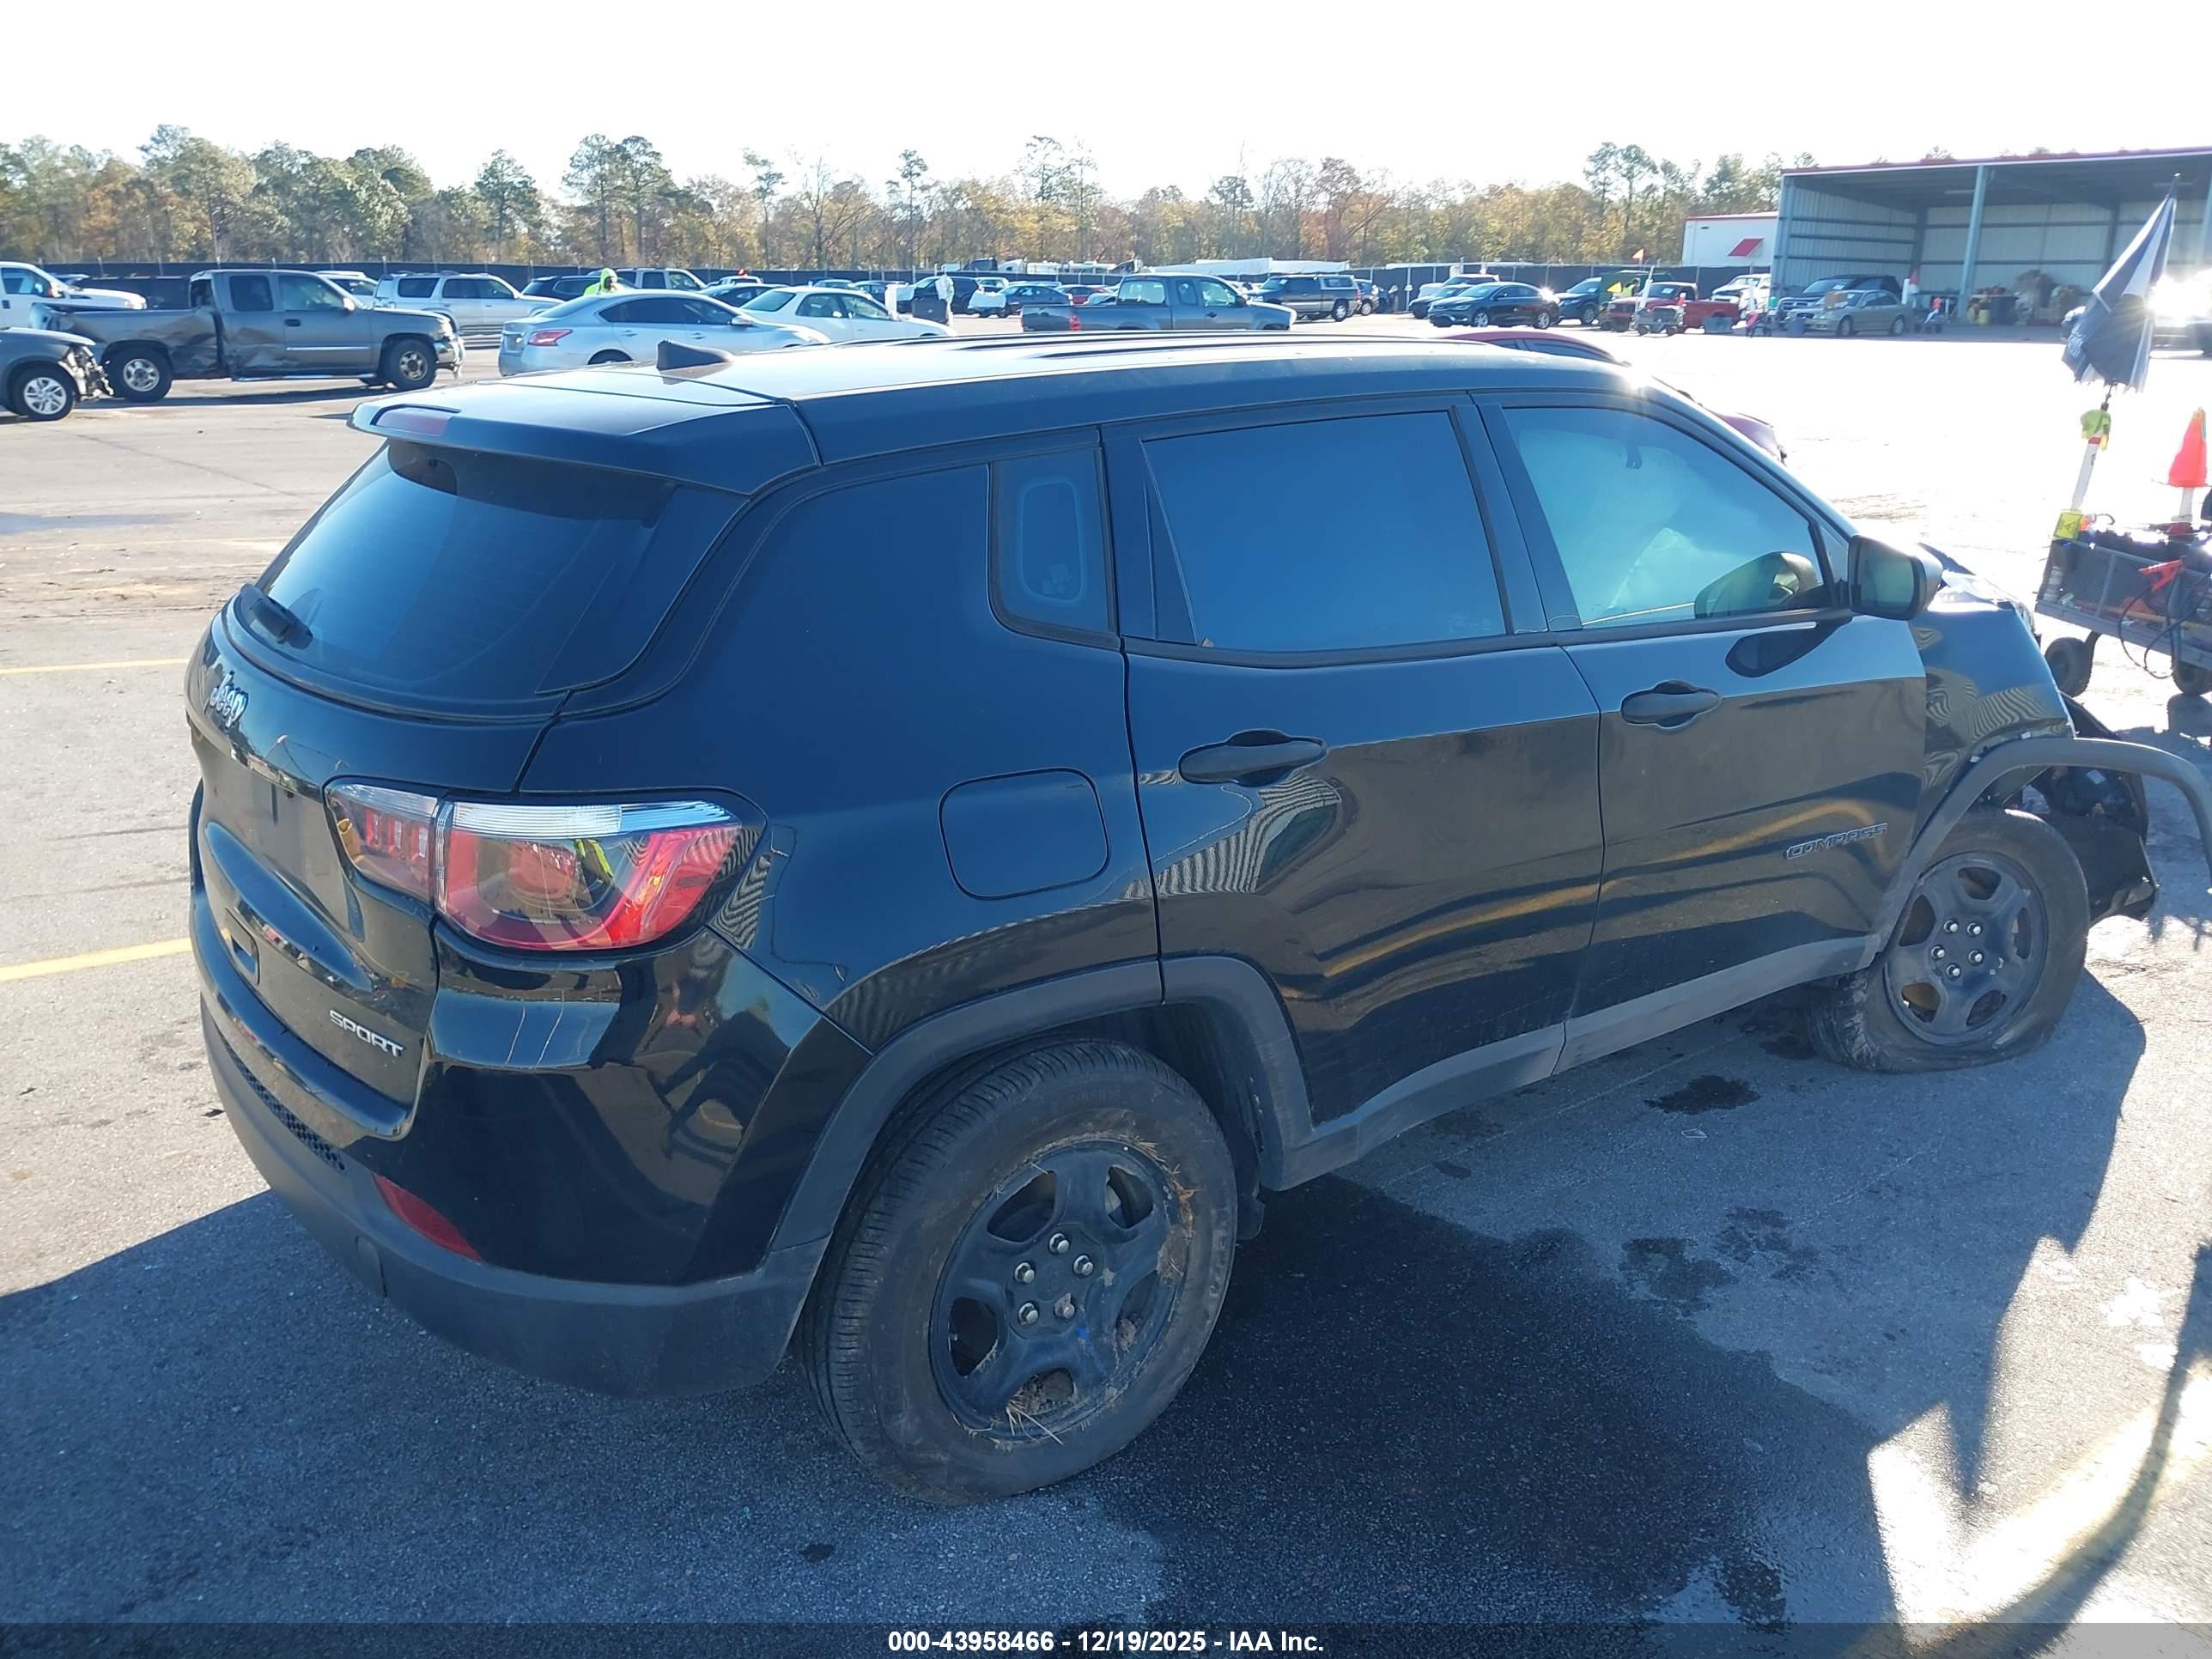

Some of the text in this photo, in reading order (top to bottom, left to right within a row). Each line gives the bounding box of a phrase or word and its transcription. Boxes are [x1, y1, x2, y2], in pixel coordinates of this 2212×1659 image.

[210, 672, 247, 728] Jeep
[1785, 822, 1888, 860] COMPASS
[329, 1009, 404, 1057] SPORT
